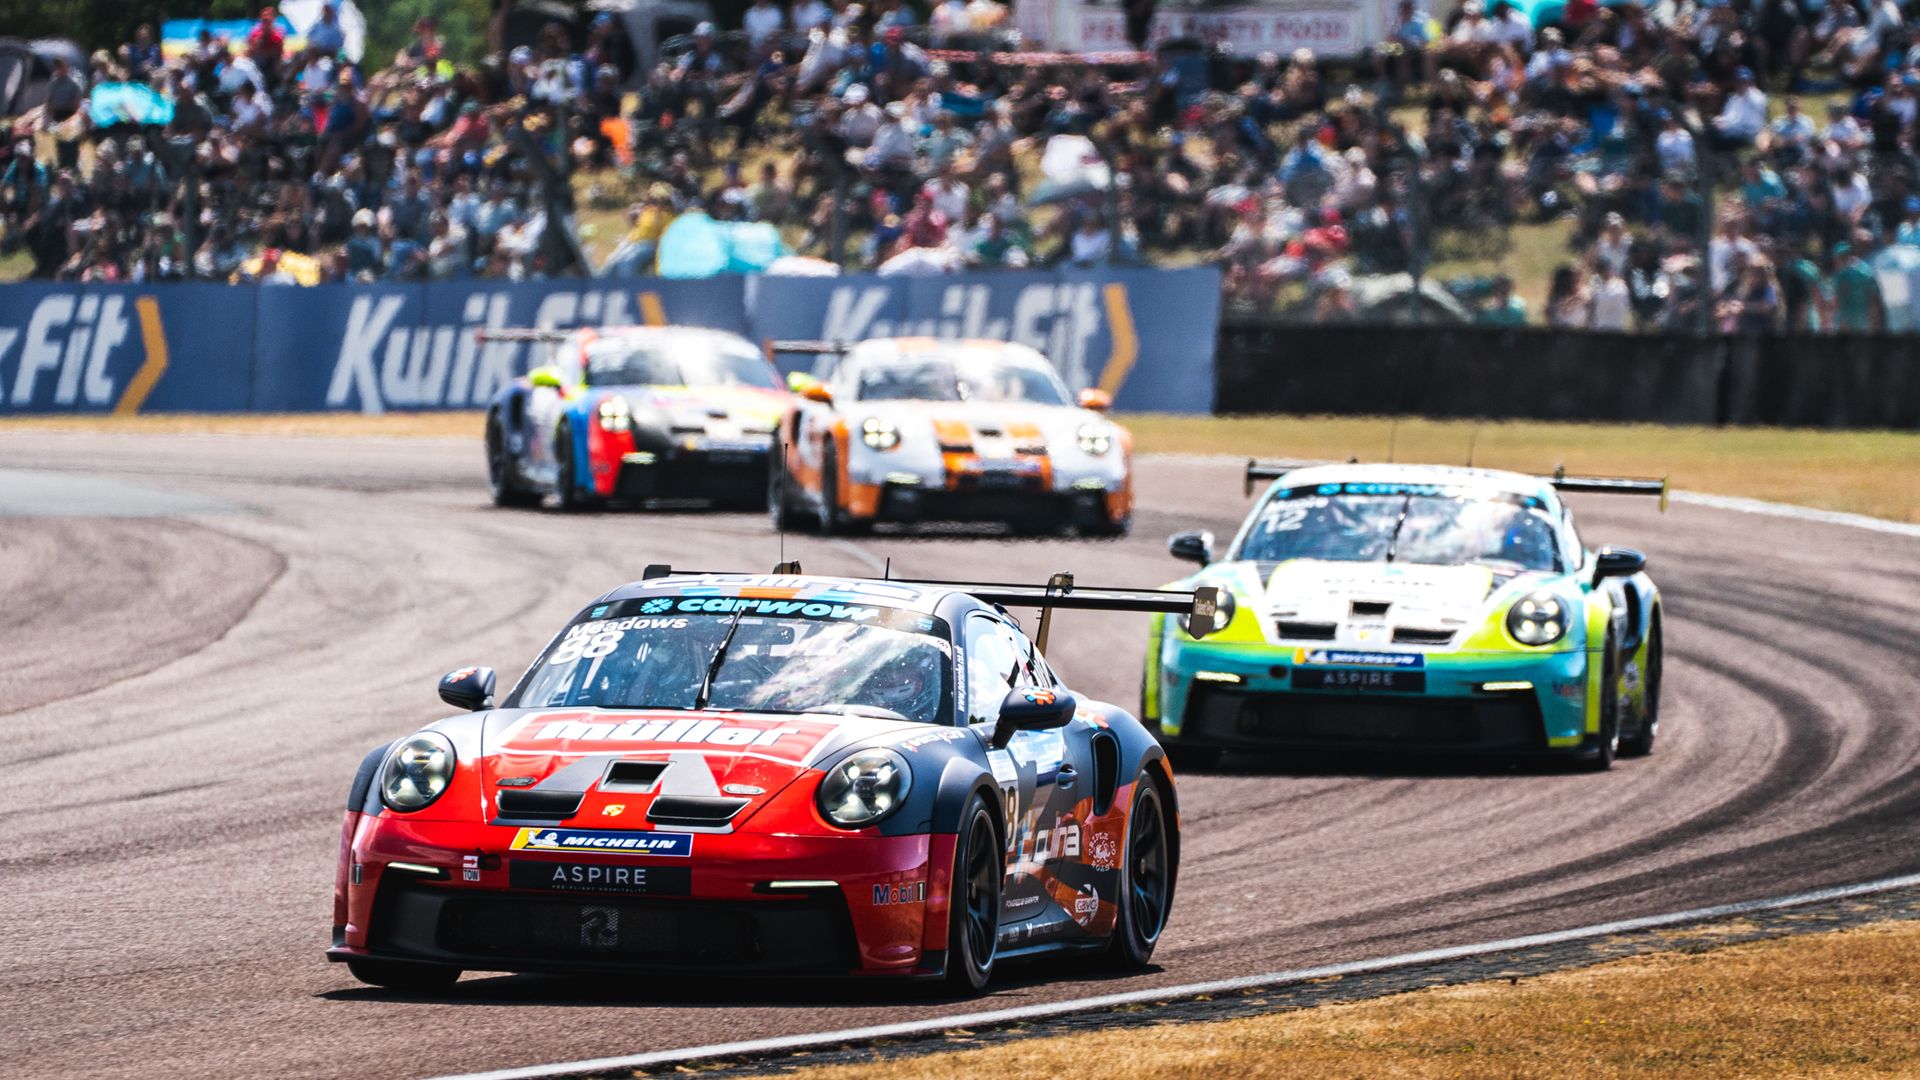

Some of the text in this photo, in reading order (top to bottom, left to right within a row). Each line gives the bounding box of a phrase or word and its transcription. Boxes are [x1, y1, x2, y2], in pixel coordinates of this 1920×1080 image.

[1264, 508, 1308, 534] 12
[677, 597, 880, 622] carwow
[563, 616, 689, 640] Meadows
[549, 629, 625, 665] 88
[1331, 652, 1416, 664] MICHELIN
[1322, 671, 1394, 686] ASPIRE
[533, 718, 800, 747] müller
[562, 836, 677, 849] MICHELIN
[464, 870, 479, 881] TOW
[552, 865, 647, 885] ASPIRE
[873, 883, 914, 906] Mobil
